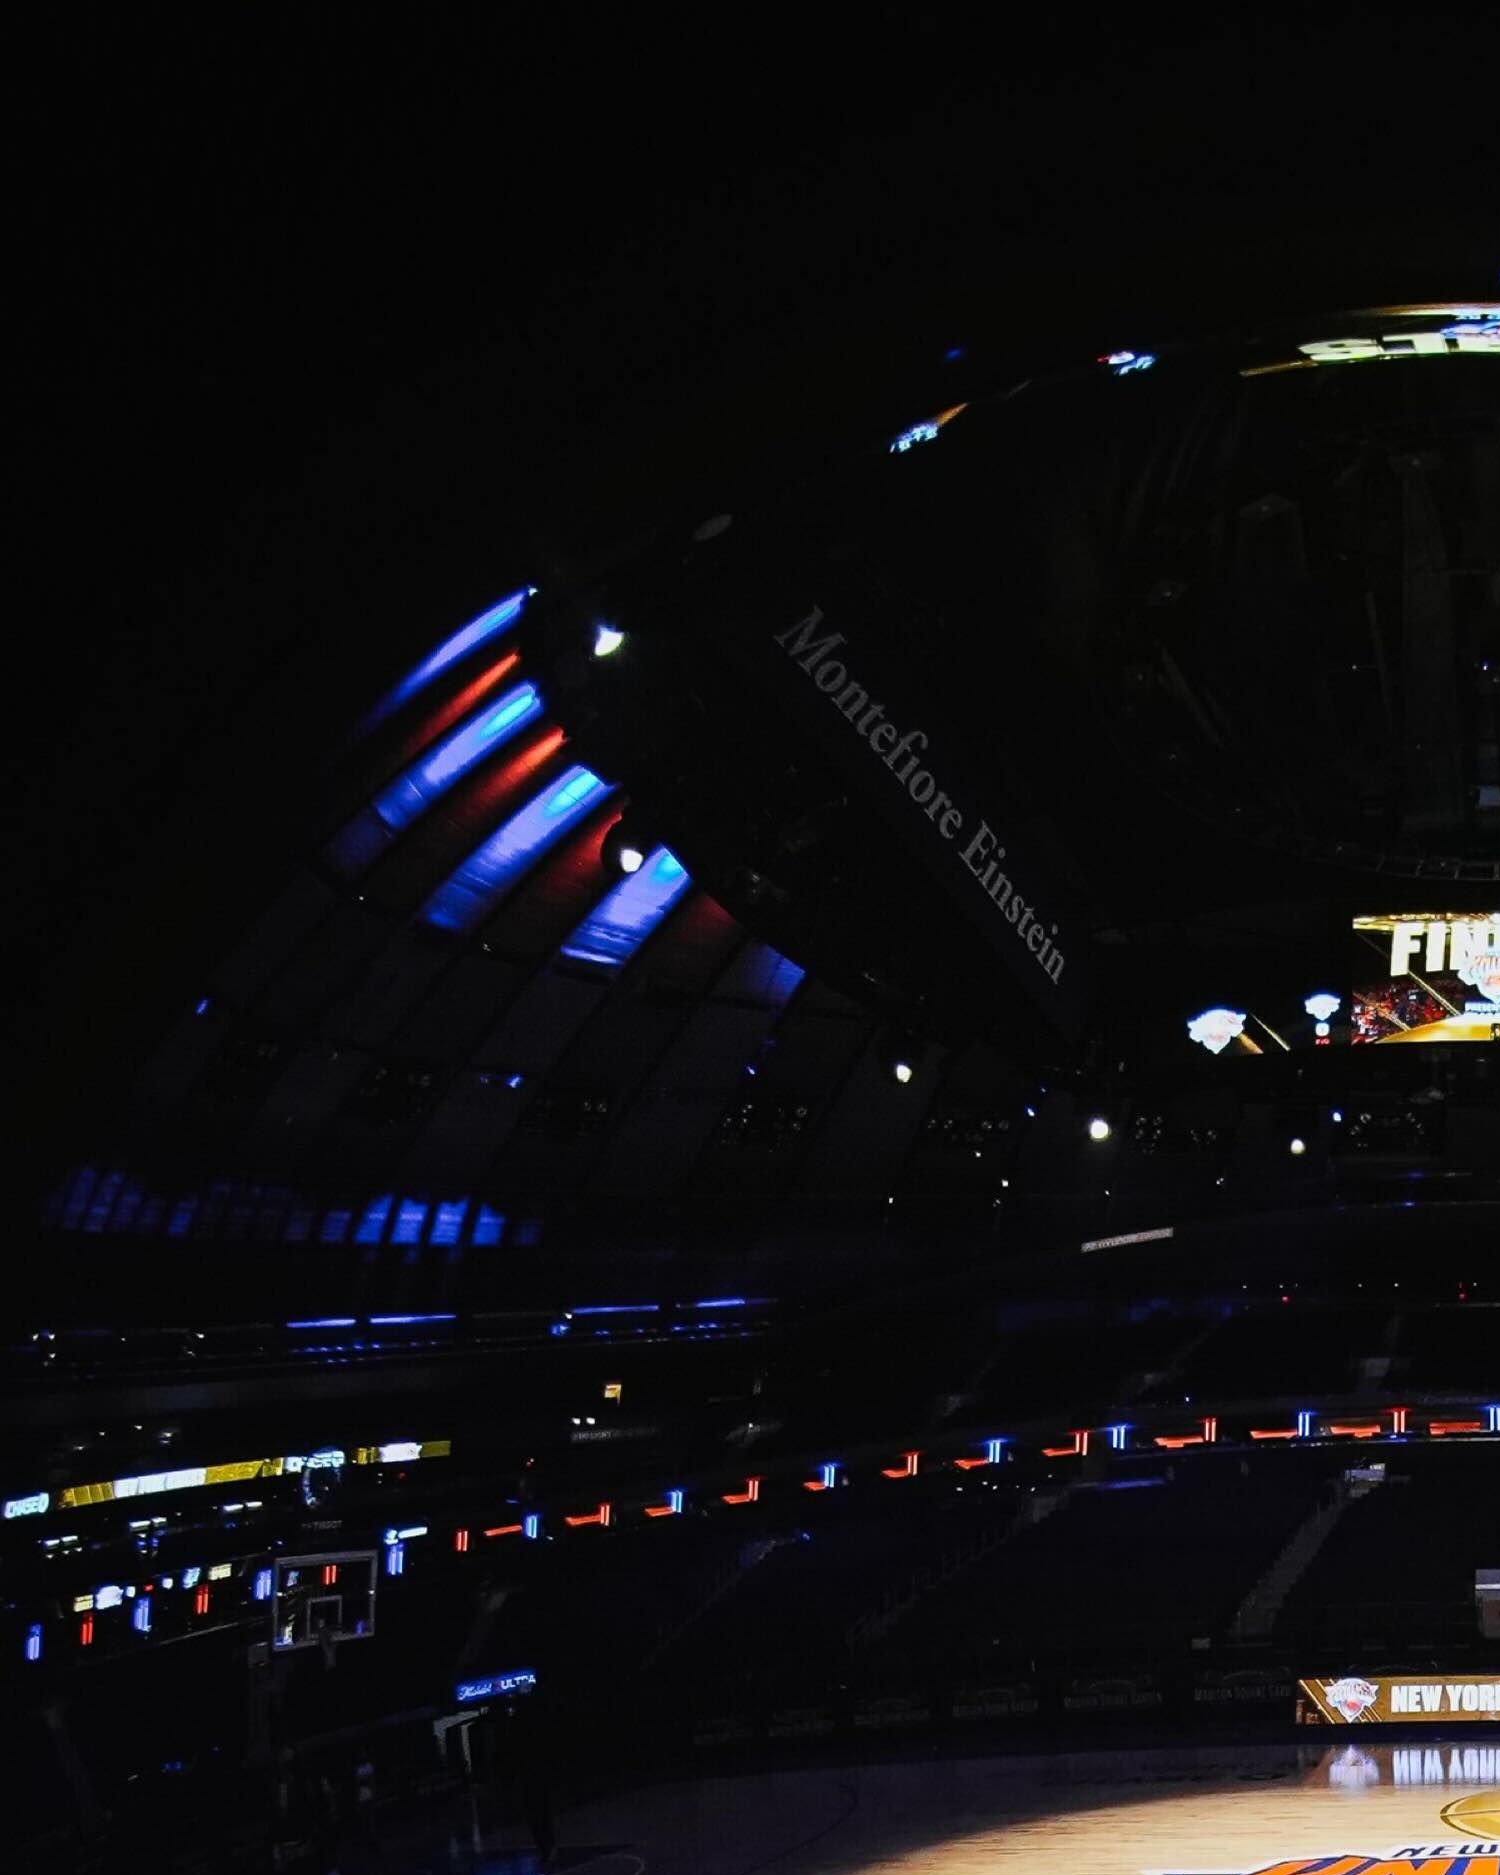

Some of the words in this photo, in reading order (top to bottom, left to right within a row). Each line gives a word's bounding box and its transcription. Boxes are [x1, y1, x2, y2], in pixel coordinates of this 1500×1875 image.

[772, 603, 964, 840] Montefiore
[958, 817, 1066, 984] Einstein
[1390, 1685, 1445, 1713] NEW
[1392, 1844, 1499, 1858] NEW
